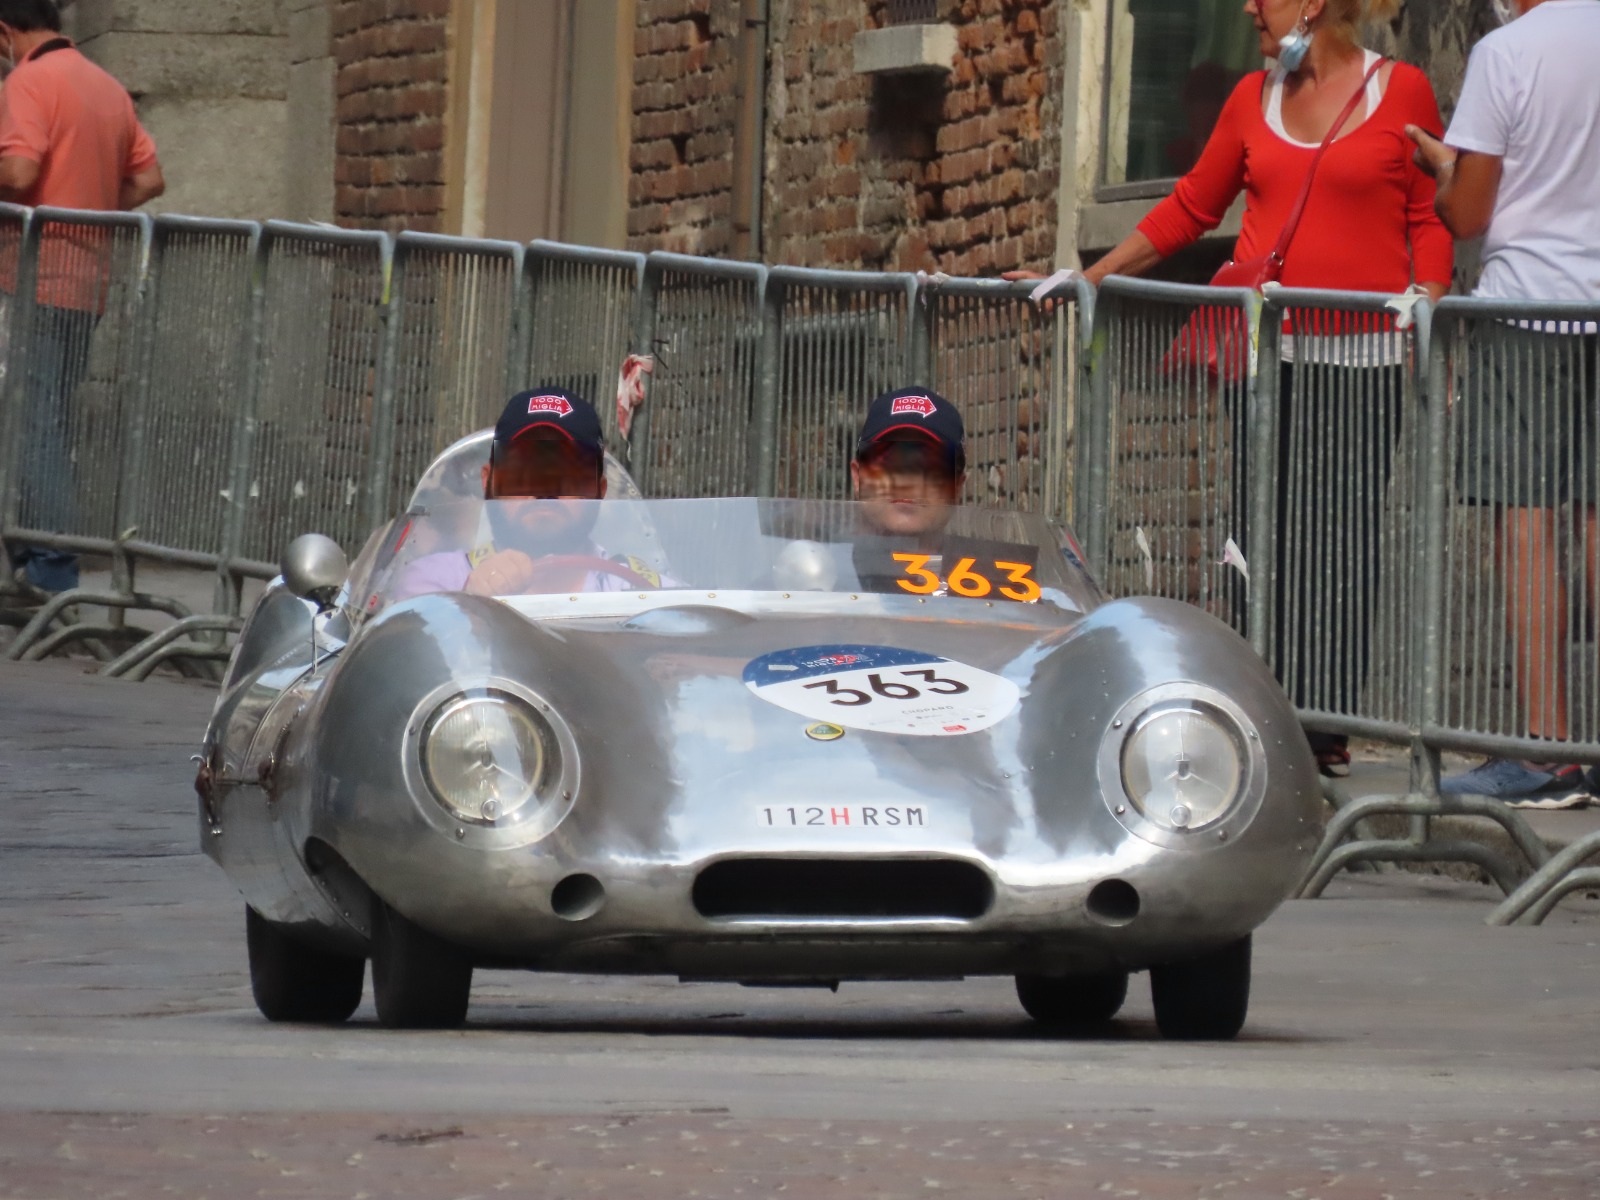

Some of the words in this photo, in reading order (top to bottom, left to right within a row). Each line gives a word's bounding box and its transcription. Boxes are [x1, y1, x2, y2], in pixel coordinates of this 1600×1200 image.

[892, 552, 1043, 603] 363
[802, 669, 970, 706] 363
[862, 807, 924, 826] RSM
